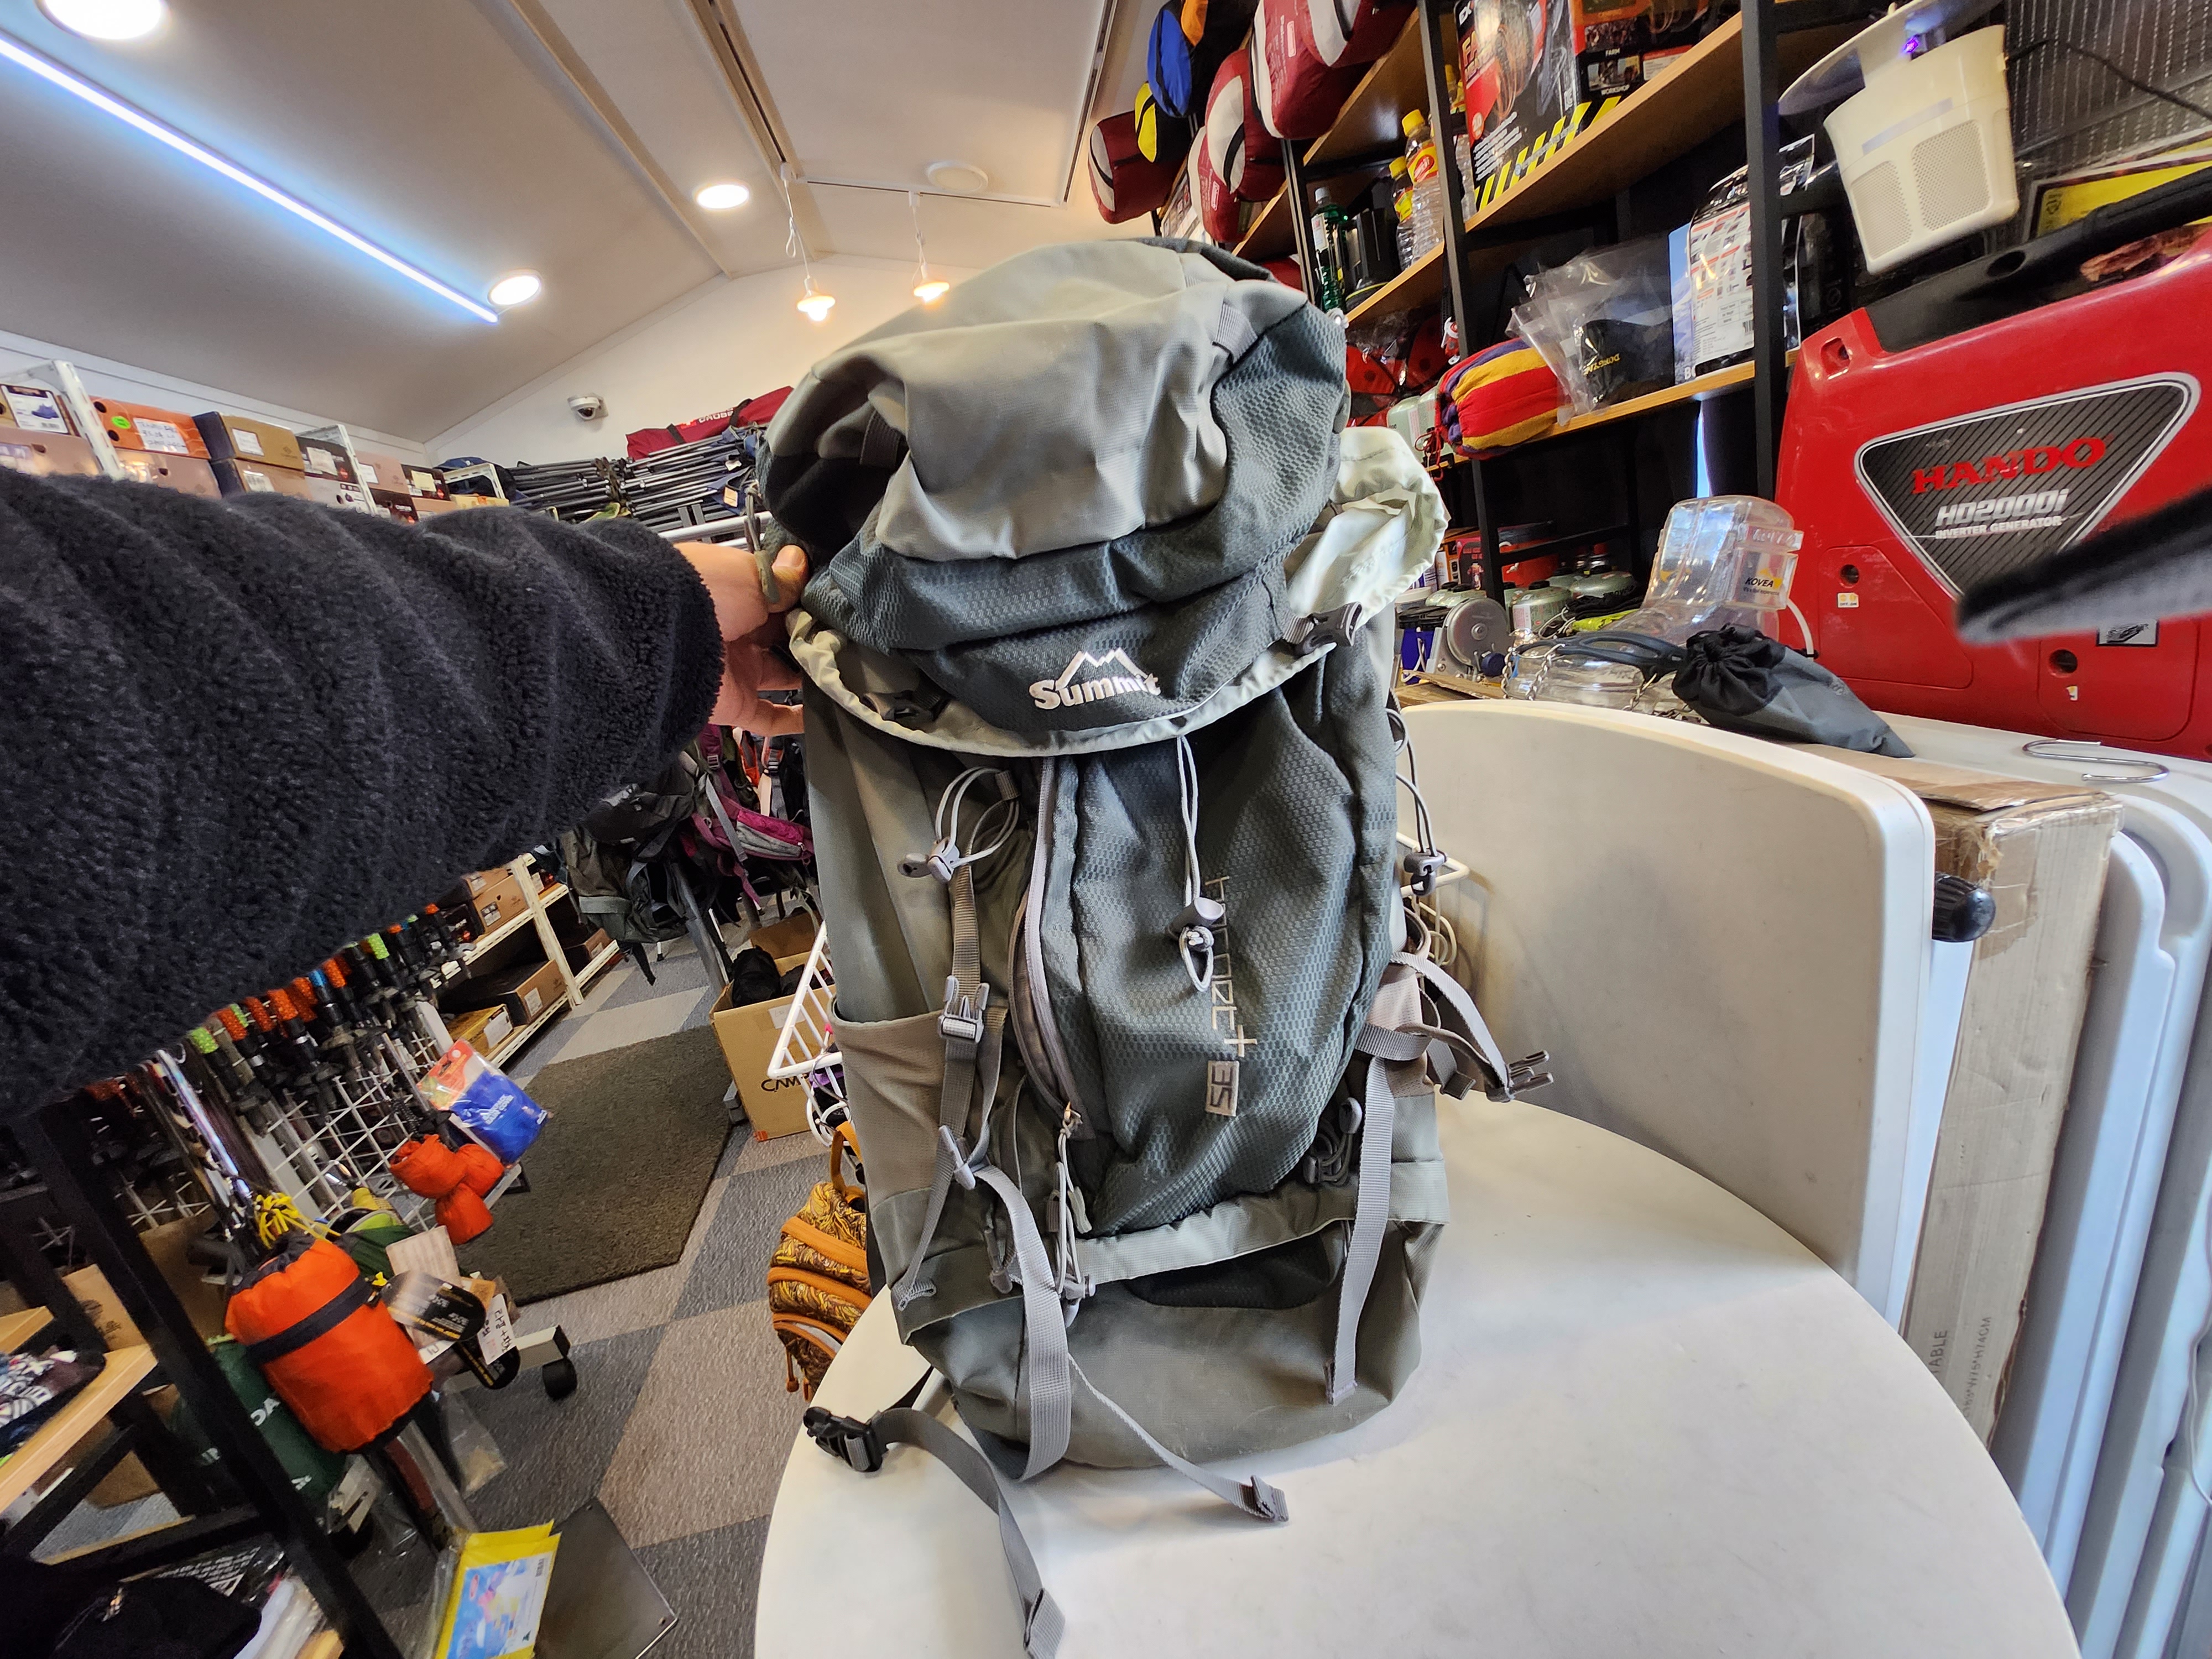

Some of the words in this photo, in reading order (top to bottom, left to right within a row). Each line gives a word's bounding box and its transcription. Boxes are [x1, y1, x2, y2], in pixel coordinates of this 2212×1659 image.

[1605, 48, 1621, 57] FARM
[1601, 84, 1630, 96] WORKSHOP
[1912, 437, 2106, 494] HANDO
[1936, 488, 2070, 526] HD2000i
[1936, 525, 1987, 539] INVERTER
[1990, 515, 2062, 533] GENERATOR
[1745, 577, 1774, 588] KOVEA
[1028, 672, 1162, 711] Summit
